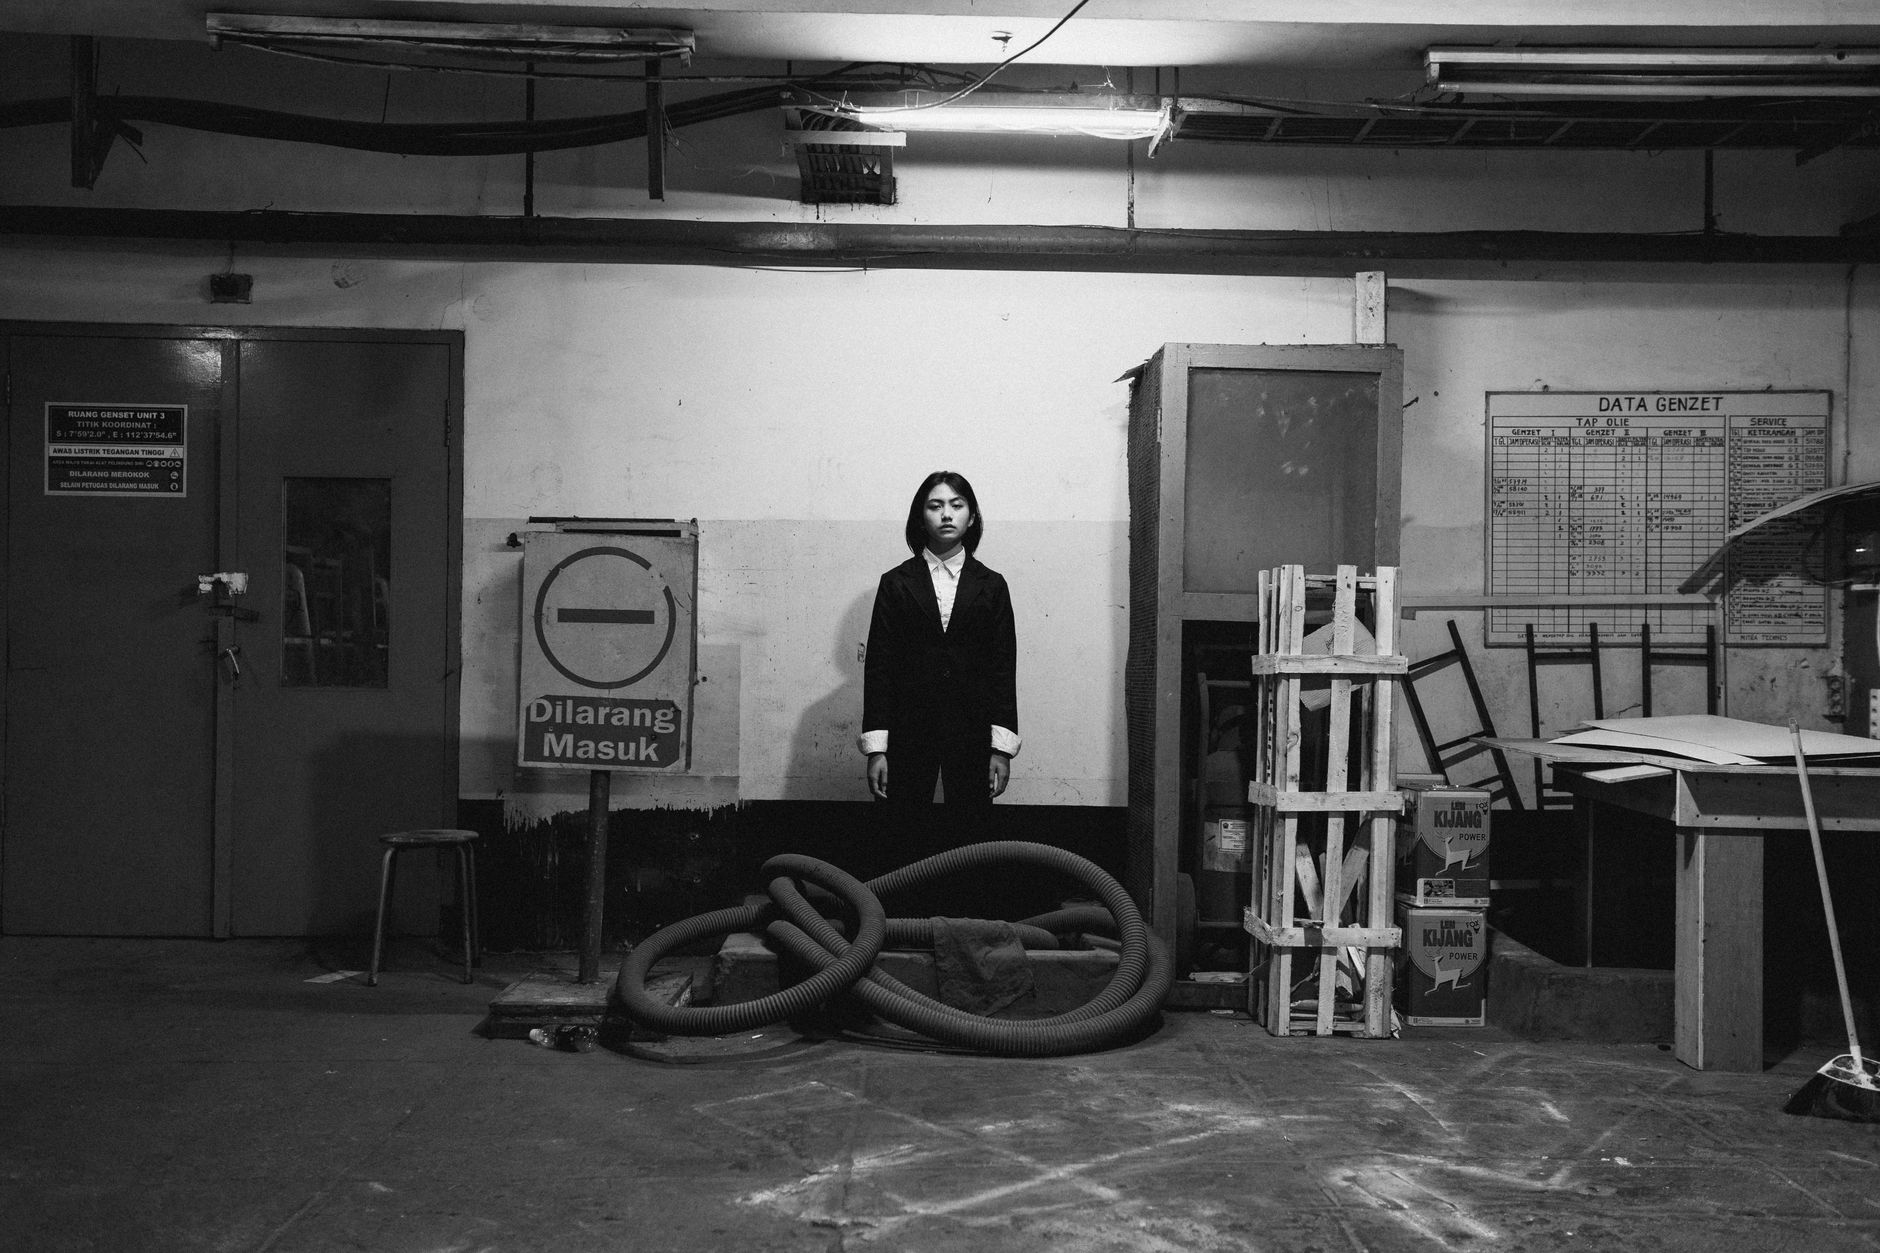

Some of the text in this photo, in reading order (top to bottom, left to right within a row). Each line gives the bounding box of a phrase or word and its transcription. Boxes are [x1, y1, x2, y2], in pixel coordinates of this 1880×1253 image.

[1599, 396, 1724, 412] DATA GENZET
[68, 410, 98, 418] RUANG
[100, 411, 135, 419] GENSET
[137, 411, 158, 419] UNIT
[101, 421, 152, 429] KOORDINAT
[1576, 417, 1630, 427] TAP OLIE
[1750, 417, 1787, 426] SERVICE
[1511, 428, 1541, 436] GENZET
[1585, 428, 1616, 436] GENZET
[102, 448, 140, 456] TEGANGAN
[141, 449, 165, 457] TINGGI
[529, 698, 676, 734] Dilarang
[543, 732, 659, 762] Masuk
[1475, 801, 1489, 810] FOX
[1433, 810, 1482, 829] KIJANG
[1459, 833, 1486, 841] POWER
[1465, 920, 1480, 929] FOX
[1422, 928, 1473, 948] KIJANG
[1449, 952, 1478, 961] POWER
